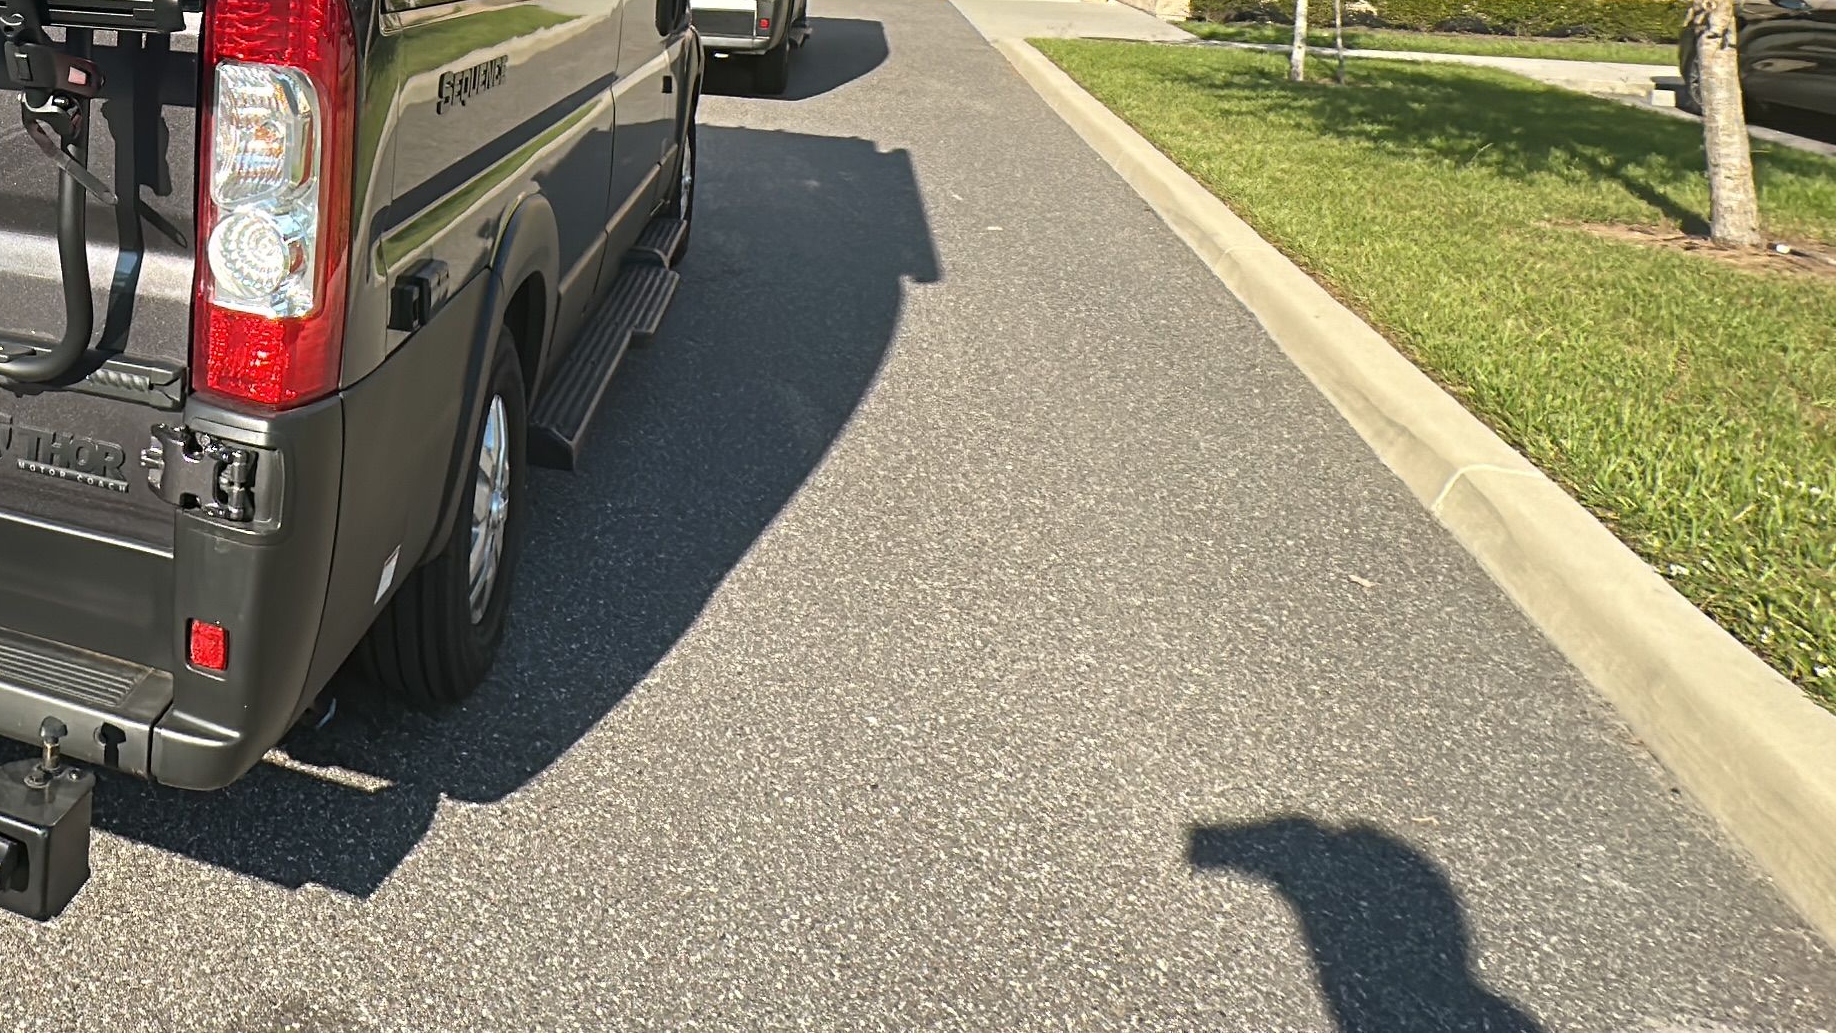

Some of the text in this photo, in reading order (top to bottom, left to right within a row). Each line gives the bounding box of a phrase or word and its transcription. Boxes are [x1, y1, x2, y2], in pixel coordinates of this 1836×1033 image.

[436, 54, 509, 116] SEQUENCE
[16, 424, 129, 483] THOR
[18, 461, 127, 492] MOTOR COACH
